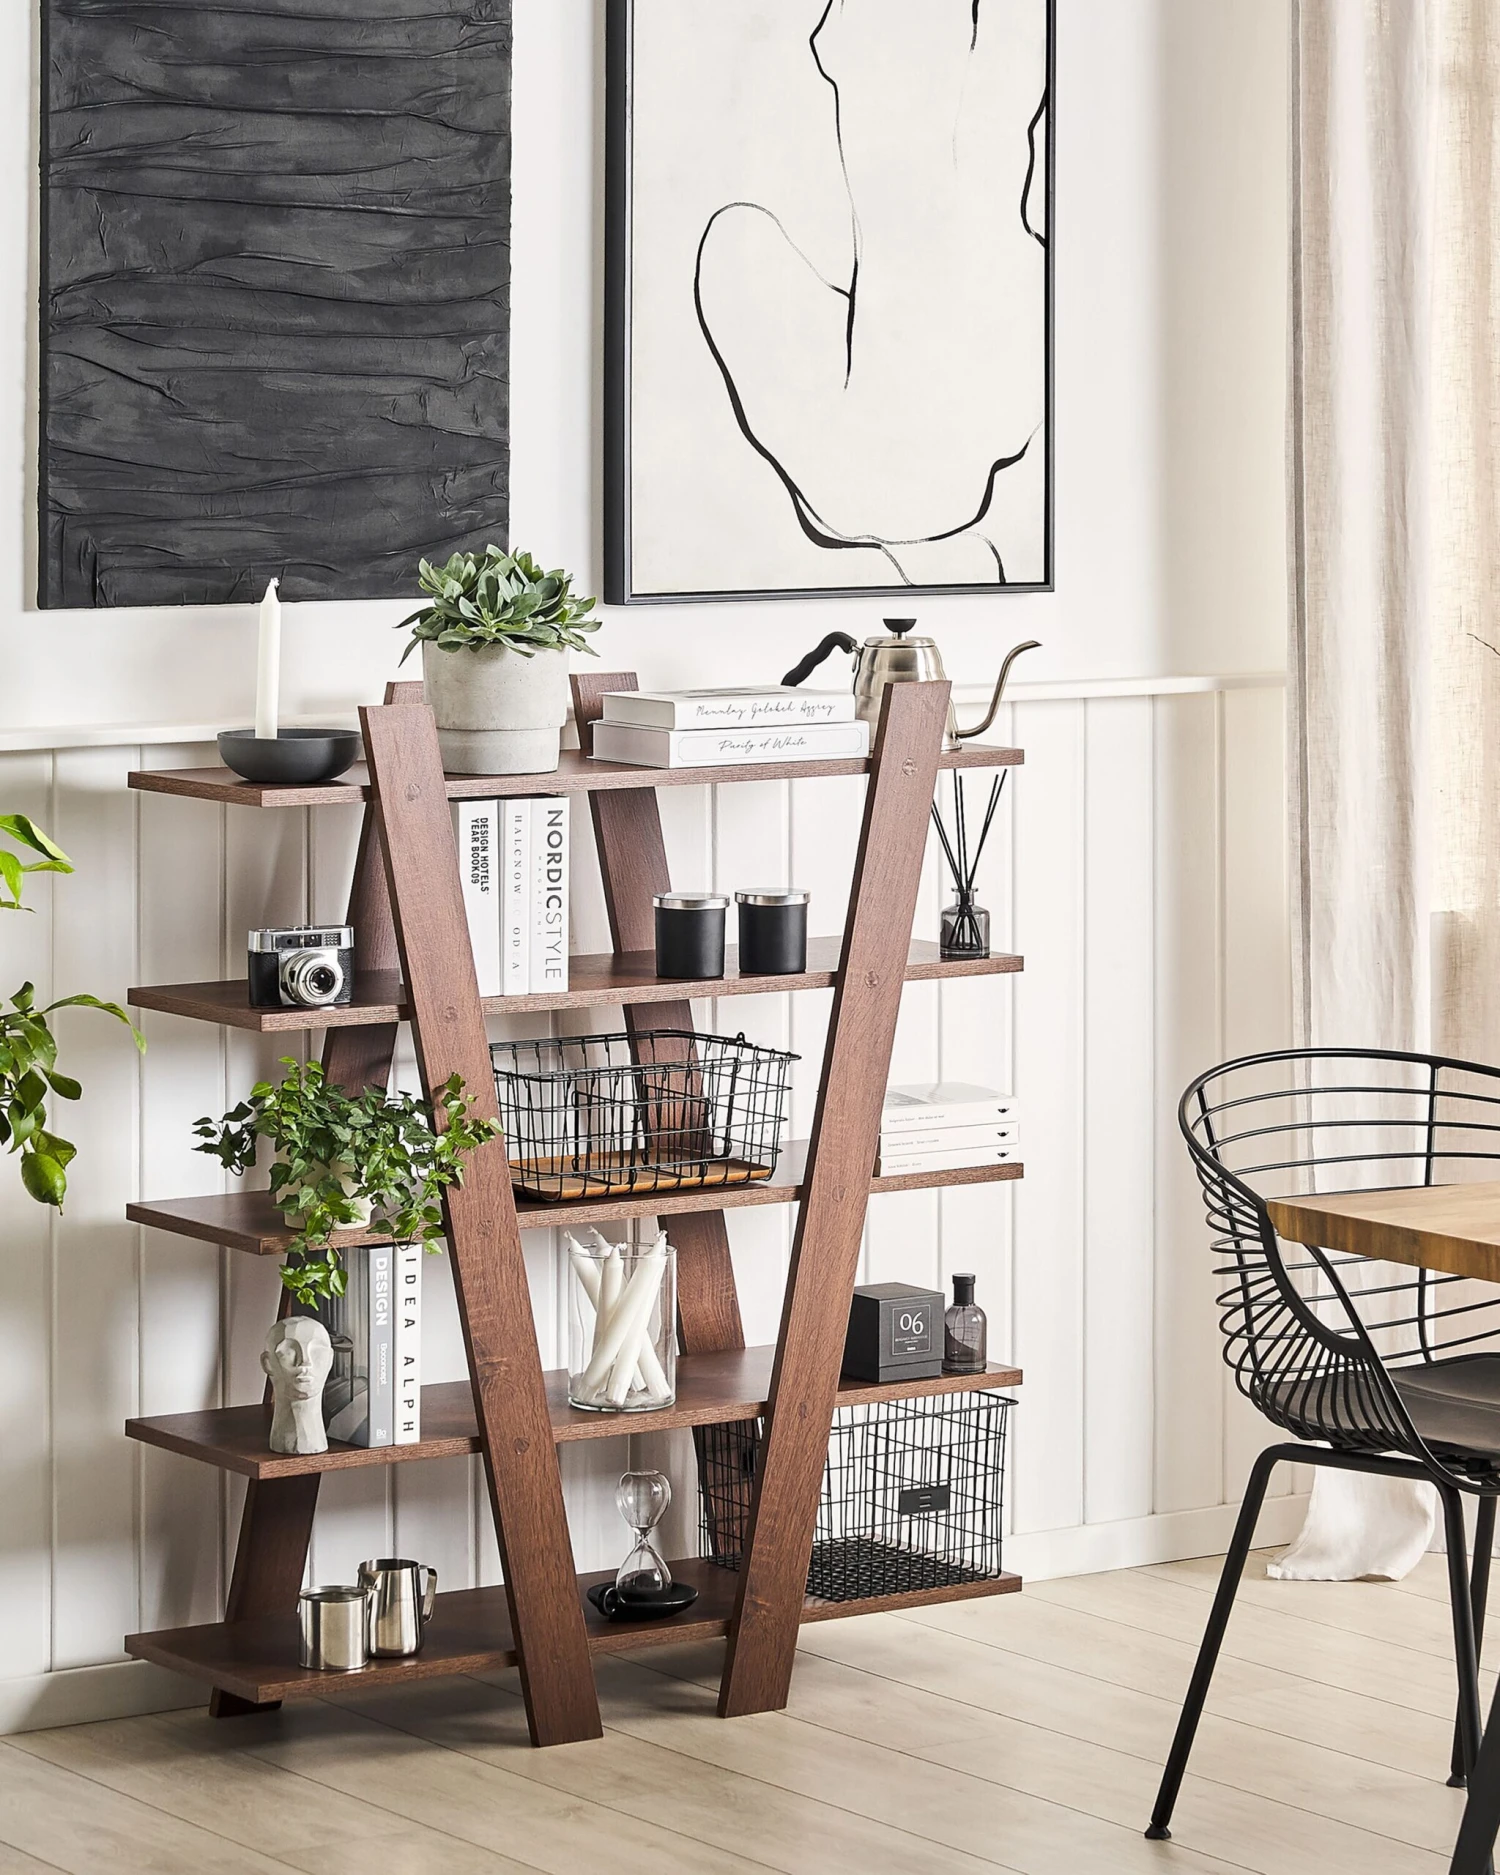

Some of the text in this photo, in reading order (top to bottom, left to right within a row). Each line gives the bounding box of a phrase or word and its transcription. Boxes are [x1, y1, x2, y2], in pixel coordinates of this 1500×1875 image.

[718, 736, 807, 754] Purity of White
[472, 818, 480, 843] YEAR
[480, 818, 490, 892] DESIGN HOTELS
[375, 1257, 388, 1326] DESIGN
[403, 1258, 417, 1432] IDEA ALPH
[900, 1312, 923, 1335] 06
